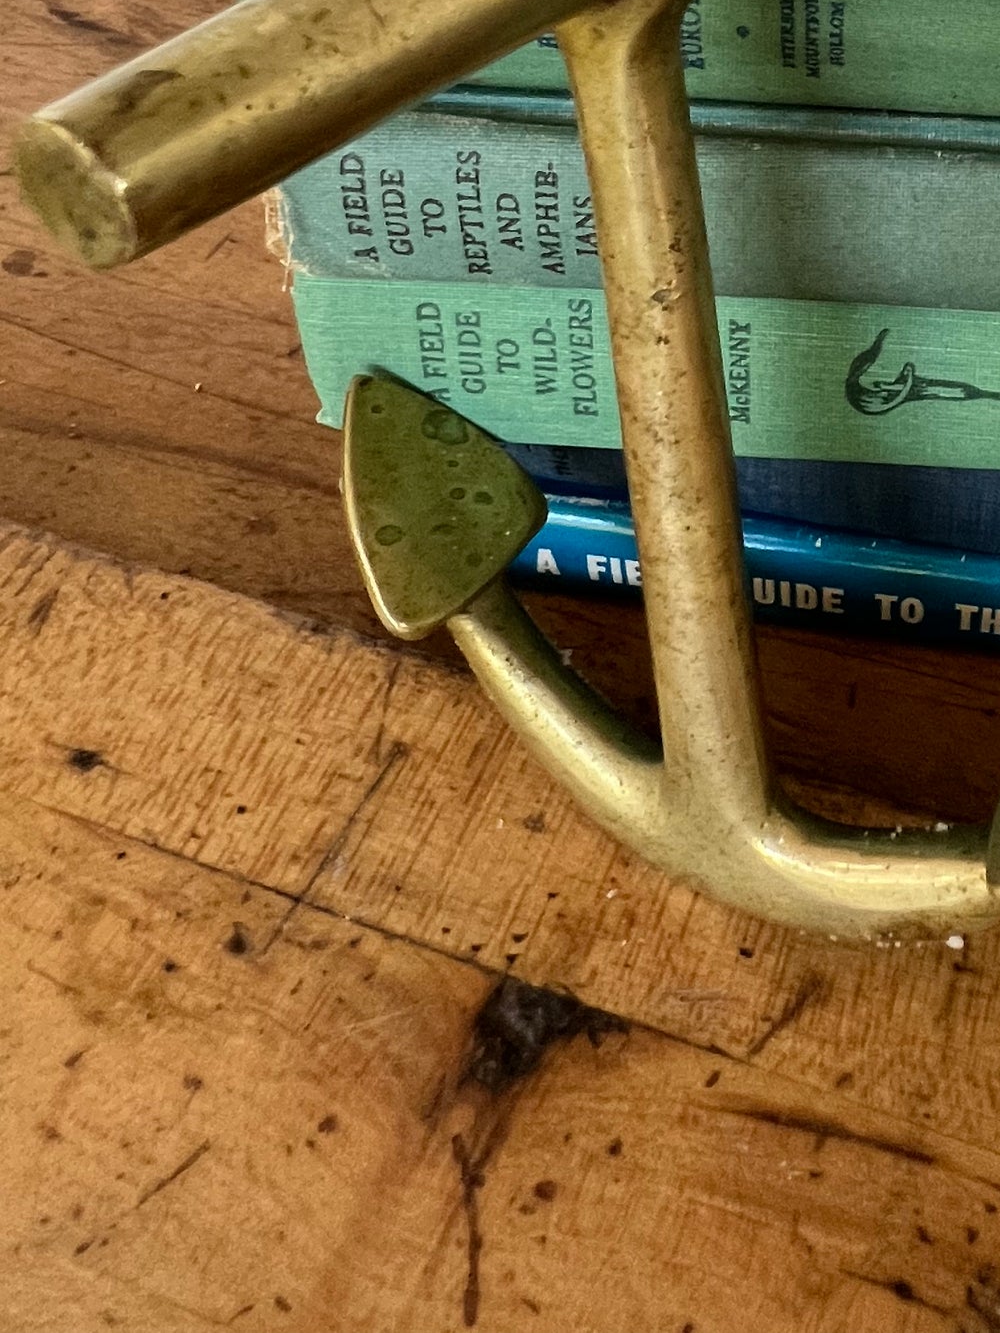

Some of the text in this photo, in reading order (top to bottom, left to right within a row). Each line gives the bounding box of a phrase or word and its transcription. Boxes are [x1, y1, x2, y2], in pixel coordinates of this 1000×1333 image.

[829, 1, 845, 66] HOLLOM
[340, 151, 379, 263] A FIELD
[380, 168, 414, 256] GUIDE
[420, 198, 447, 238] TO
[456, 150, 493, 275] REPTILES
[496, 192, 525, 251] AND
[535, 162, 567, 275] AMPHIB-
[573, 196, 598, 256] IANS
[416, 302, 448, 379] FIELD
[455, 311, 487, 394] GUIDE
[496, 338, 521, 374] TO
[532, 318, 559, 395] WILD-
[568, 298, 600, 417] FLOWERS
[729, 319, 751, 425] McKENNY
[536, 548, 561, 575] A
[586, 554, 643, 587] FIE
[753, 577, 845, 615] UIDE
[874, 593, 925, 625] TO
